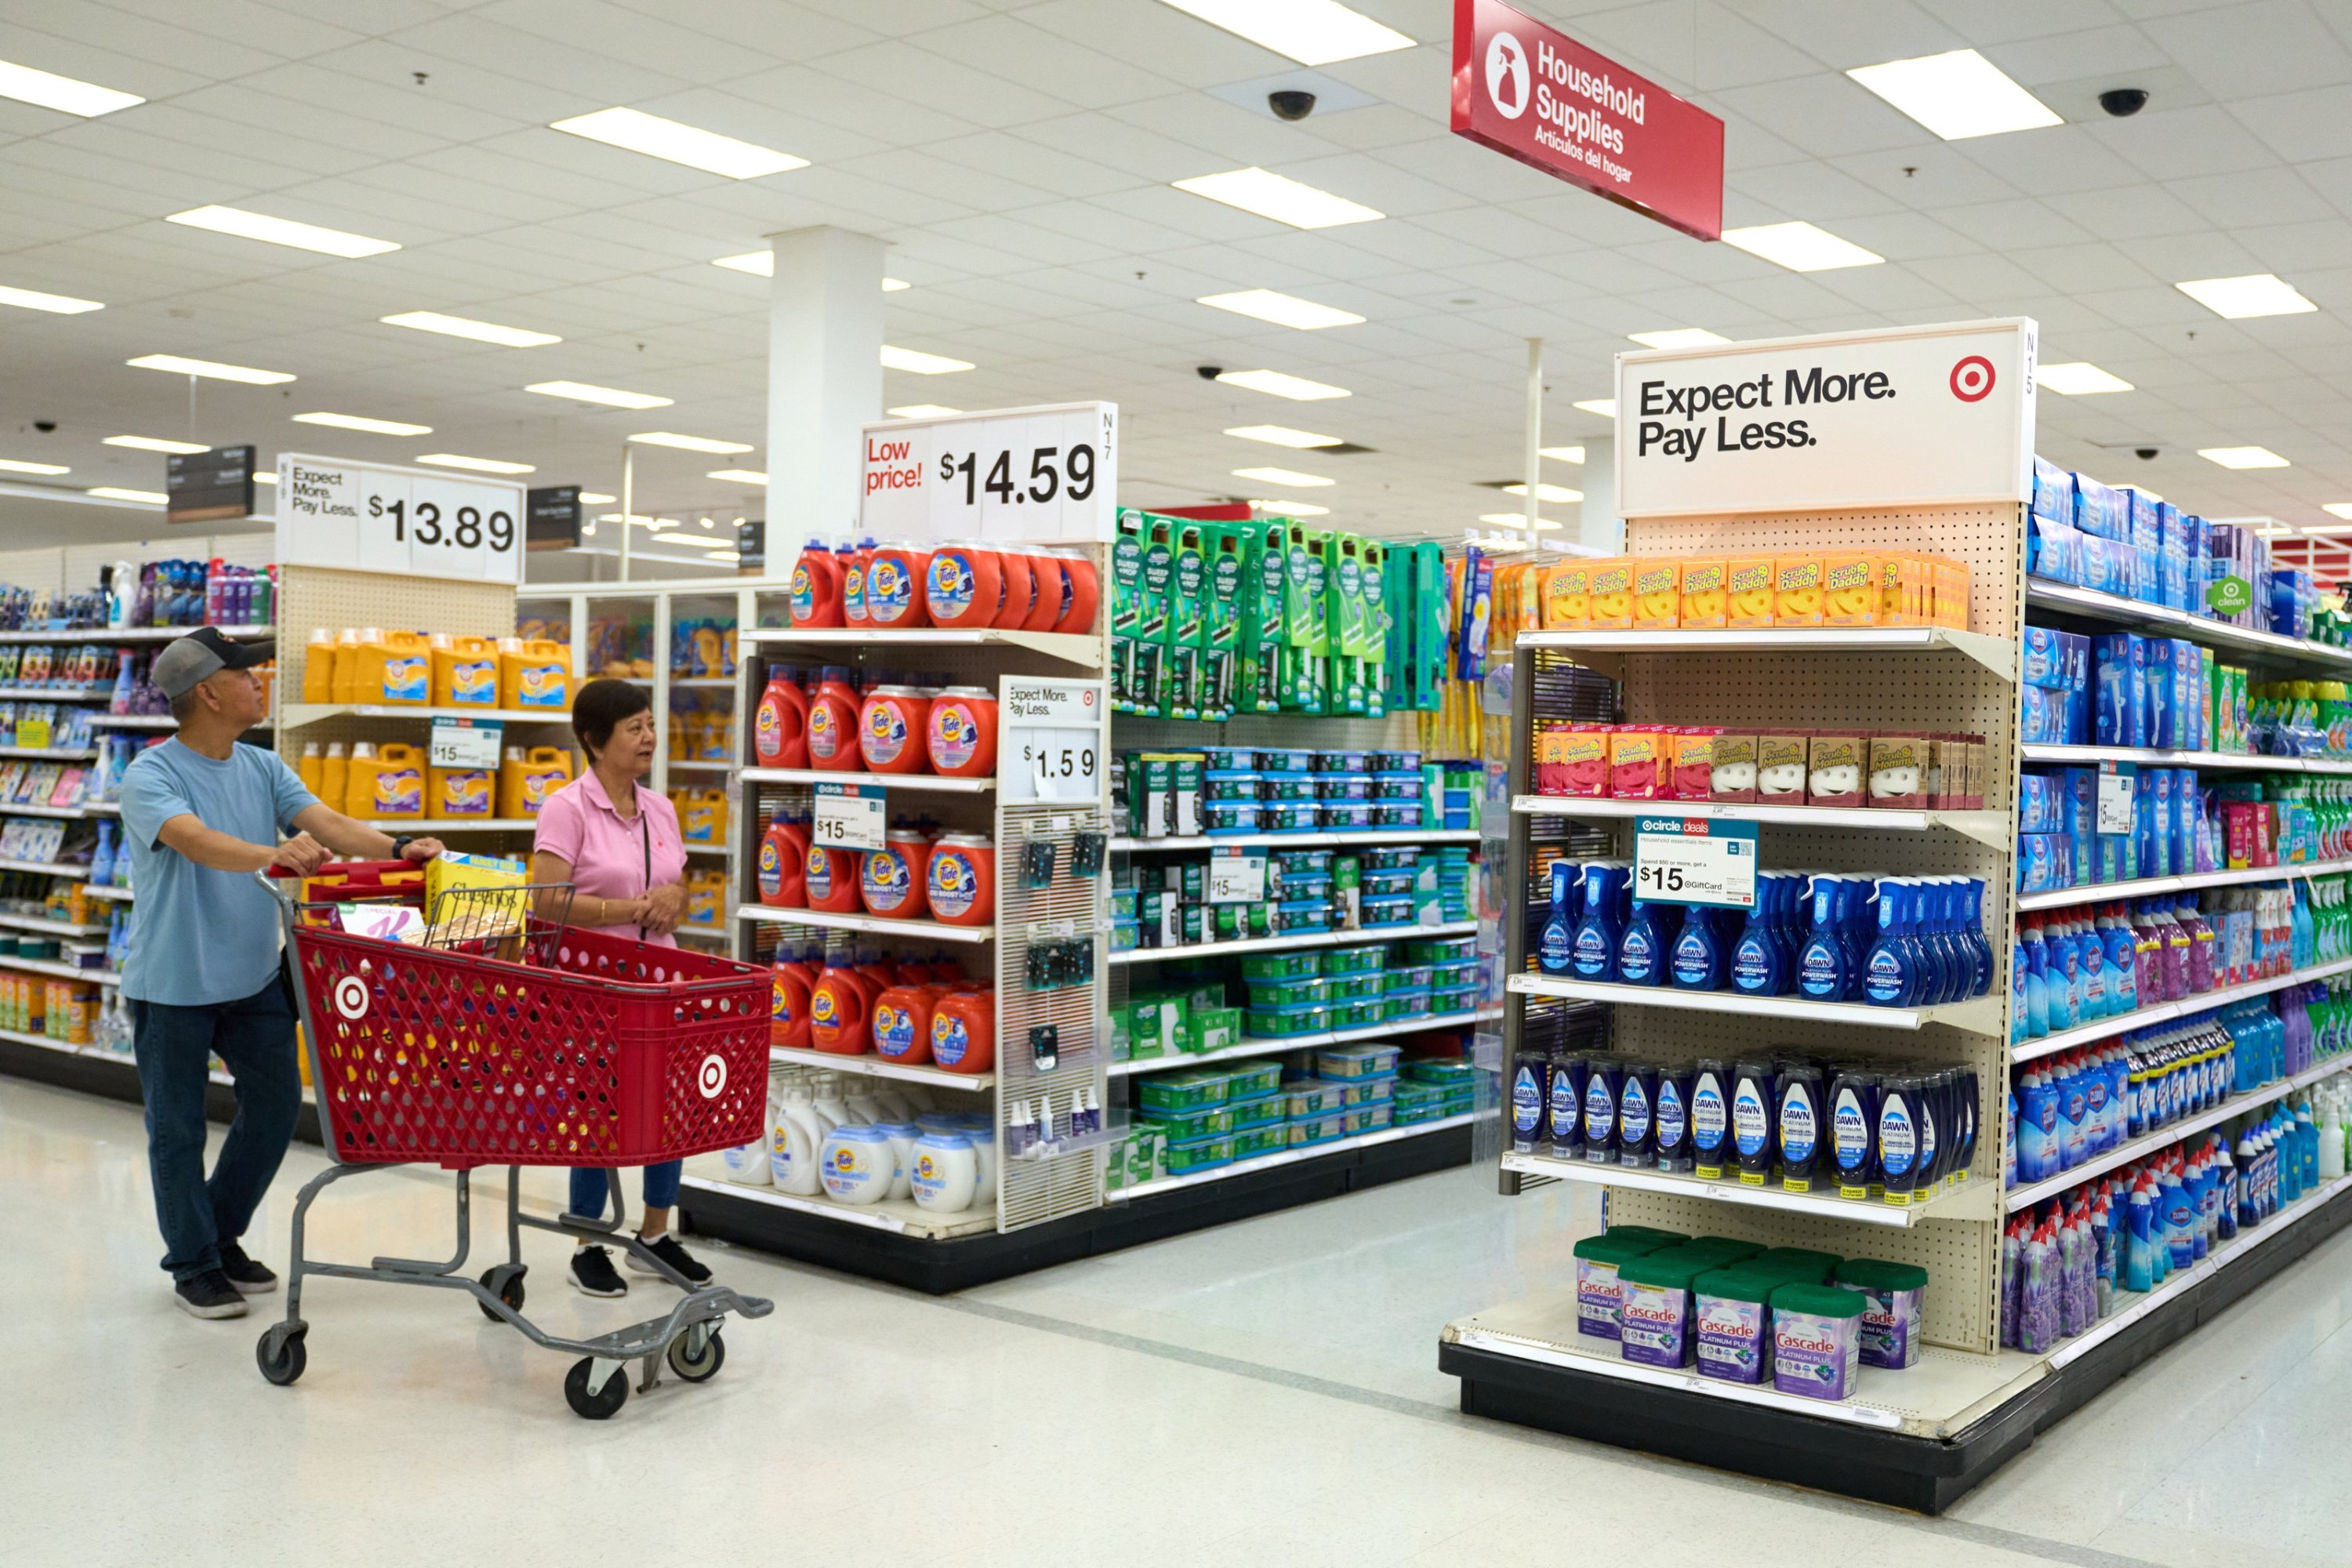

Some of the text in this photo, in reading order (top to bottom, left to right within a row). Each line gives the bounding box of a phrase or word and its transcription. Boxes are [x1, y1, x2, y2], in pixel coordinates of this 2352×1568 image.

[1537, 41, 1645, 125] Household
[1537, 84, 1624, 154] Supplies
[1534, 125, 1632, 183] Artículos del hogar
[1640, 367, 1896, 421] Expect More.
[1639, 416, 1817, 463] Pay Less.
[868, 438, 910, 463] Low
[293, 467, 343, 485] Expect
[866, 463, 922, 496] price!
[940, 444, 1095, 505] $14.59
[293, 482, 332, 499] More.
[292, 497, 358, 517] Pay Less.
[368, 494, 514, 552] $13.89
[877, 571, 895, 586] Tide
[938, 565, 957, 583] Tide
[1553, 573, 1577, 586] Scrub
[1593, 571, 1617, 586] Scrub
[1638, 572, 1662, 585] Scrub
[1686, 571, 1710, 585] Scrub
[1733, 569, 1757, 583] Scrub
[1780, 568, 1806, 581] Scrub
[1829, 566, 1857, 580] Scrub
[1594, 579, 1626, 596] Daddy
[1639, 578, 1671, 596] Daddy
[1686, 577, 1719, 594] Daddy
[1733, 575, 1767, 593] Daddy
[1780, 574, 1817, 591] Daddy
[1830, 573, 1867, 590] Daddy
[1554, 581, 1585, 597] Daddy
[2217, 596, 2245, 608] clean
[1043, 689, 1069, 702] More.
[1027, 703, 1051, 715] Less.
[760, 712, 772, 724] Tide
[812, 712, 826, 725] Tide
[872, 714, 890, 728] Tide
[941, 719, 960, 733] Tide
[1568, 744, 1590, 754] Scrub
[1619, 745, 1641, 755] Scrub
[1682, 747, 1704, 757] Scrub
[1719, 747, 1740, 757] Scrub
[1766, 749, 1790, 758] Scrub
[1818, 750, 1842, 760] Scrub
[1566, 750, 1601, 764] Mommy
[1617, 751, 1652, 764] Mommy
[1715, 753, 1753, 766] Mommy
[1763, 755, 1802, 768] Mommy
[1878, 751, 1902, 761] Scrub
[1815, 756, 1853, 770] Mommy
[1875, 757, 1915, 770] Mommy
[817, 820, 844, 839] $15
[1683, 822, 1709, 833] deals
[873, 862, 891, 876] Tide
[939, 867, 958, 880] Tide
[1640, 866, 1683, 891] $15
[1212, 880, 1229, 895] $15
[1546, 935, 1566, 944] DAWN
[1580, 940, 1599, 949] DAWN
[1625, 945, 1646, 954] DAWN
[1681, 948, 1702, 957] DAWN
[1740, 953, 1762, 963] DAWN
[1808, 957, 1830, 967] DAWN
[1873, 964, 1895, 973] DAWN
[815, 997, 832, 1012] Tide
[878, 1013, 891, 1025] Tide
[935, 1021, 947, 1033] Tide
[1515, 1088, 1536, 1097] DAWN
[1552, 1092, 1572, 1101] DAWN
[1588, 1096, 1608, 1105] DAWN
[1658, 1102, 1679, 1112] DAWN
[1695, 1098, 1721, 1109] DAWN
[1736, 1104, 1760, 1114] DAWN
[1784, 1109, 1810, 1120] DAWN
[1836, 1114, 1861, 1126] DAWN
[1882, 1120, 1909, 1131] DAWN
[837, 1153, 854, 1166] Tide
[920, 1161, 932, 1174] Tide
[1580, 1294, 1608, 1305] PLATINUM
[1623, 1304, 1676, 1323] Cascade
[1863, 1311, 1896, 1325] cade
[1624, 1319, 1656, 1330] PLATINUM
[1698, 1318, 1753, 1338] Cascade
[1875, 1327, 1893, 1335] PLUS
[1700, 1334, 1733, 1345] PLATINUM
[1776, 1333, 1835, 1353] Cascade
[1777, 1349, 1831, 1364] PLATINUM PLUS
